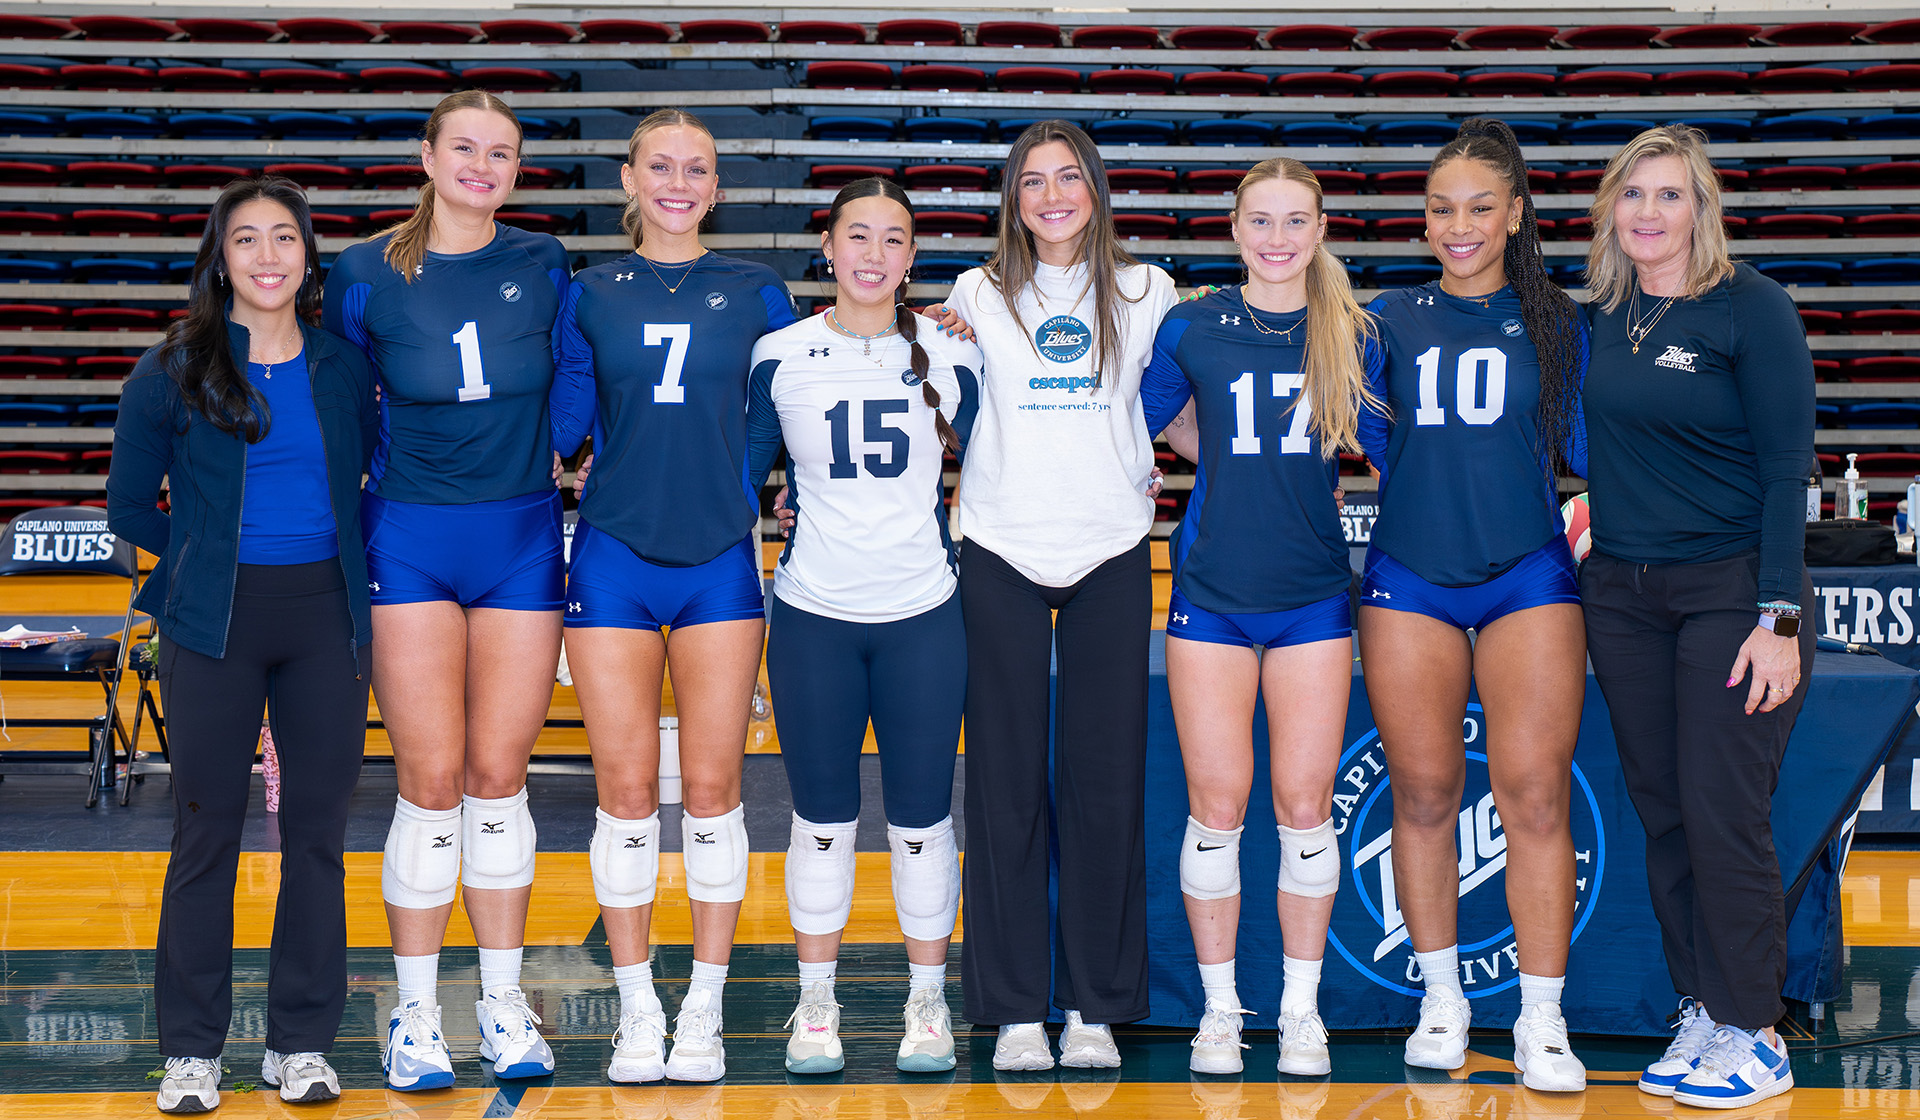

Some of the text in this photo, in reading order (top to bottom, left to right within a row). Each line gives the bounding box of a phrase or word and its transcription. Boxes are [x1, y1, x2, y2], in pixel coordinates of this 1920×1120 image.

[1044, 317, 1080, 330] CAPILANO
[1040, 330, 1088, 347] Blues
[451, 319, 491, 402] 1
[642, 322, 691, 404] 7
[1042, 345, 1087, 361] UNIVERSITY
[1655, 345, 1699, 365] Blues
[1654, 359, 1697, 373] VOLLEYBALL
[1028, 371, 1103, 394] escaped
[1415, 345, 1508, 426] 10
[1017, 403, 1057, 411] sentence
[1058, 402, 1091, 411] served:
[1092, 402, 1098, 410] 7
[1229, 371, 1312, 454] 17
[825, 399, 910, 479] 15
[15, 520, 63, 532] CAPILANO
[12, 533, 116, 562] BLUES
